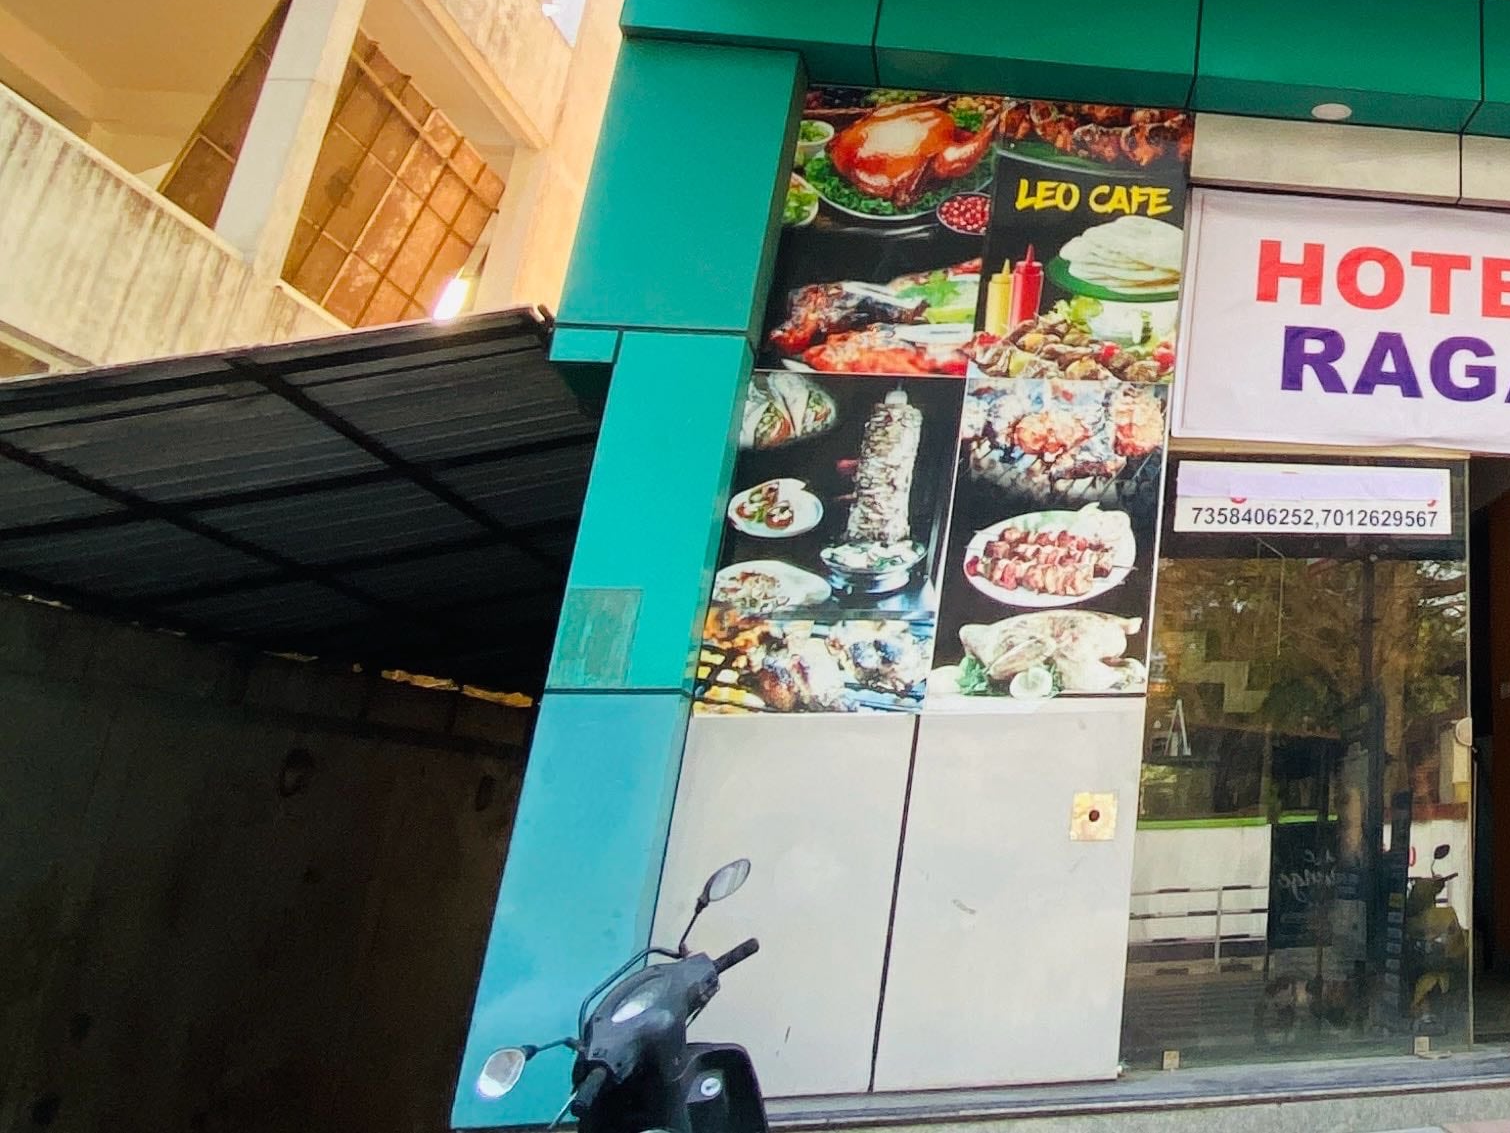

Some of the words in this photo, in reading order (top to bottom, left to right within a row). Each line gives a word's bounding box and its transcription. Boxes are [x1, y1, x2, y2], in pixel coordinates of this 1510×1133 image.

[1015, 178, 1080, 211] LEO
[1089, 185, 1173, 216] CAFE
[1192, 507, 1438, 529] 7358406252,7012629567
